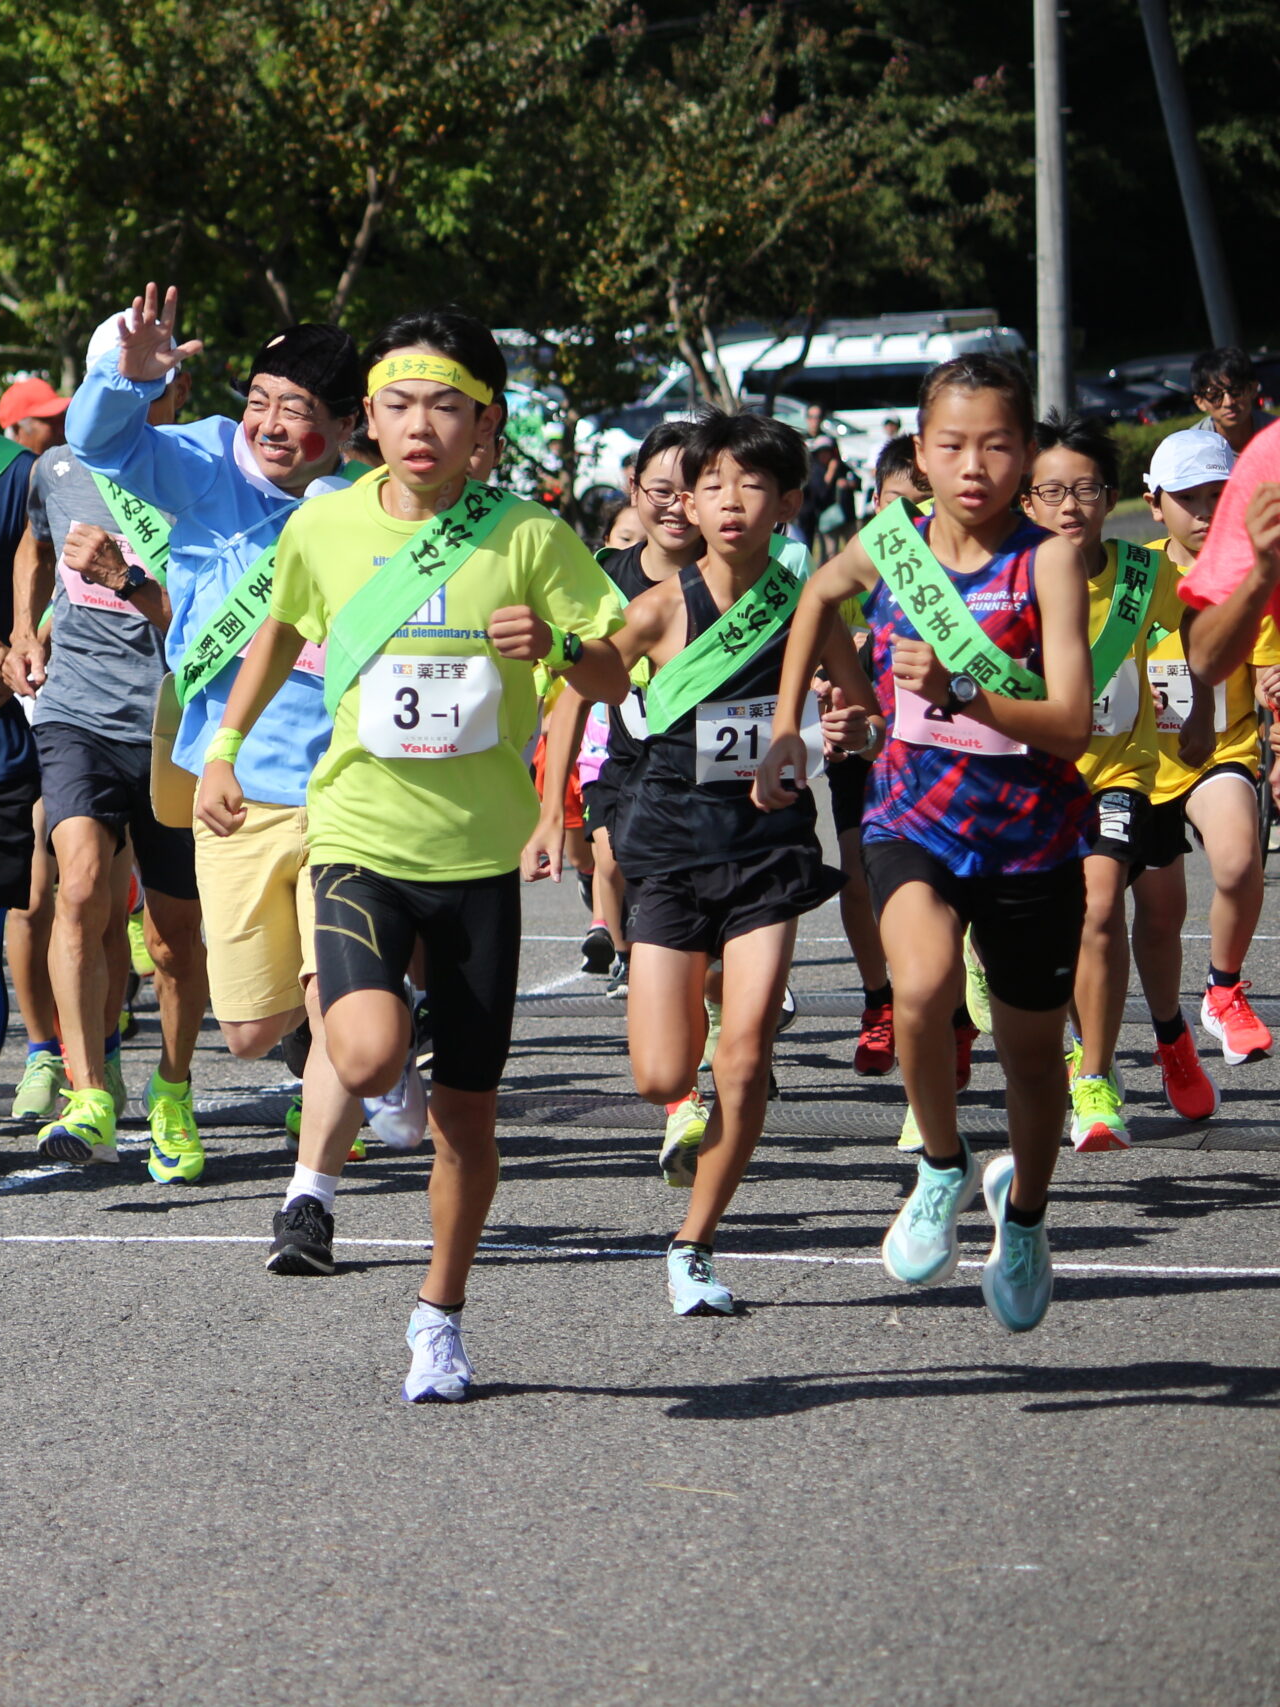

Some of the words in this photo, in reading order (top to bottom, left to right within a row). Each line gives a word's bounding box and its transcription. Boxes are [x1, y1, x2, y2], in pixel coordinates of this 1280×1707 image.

[386, 360, 463, 383] 喜多方二小
[82, 594, 126, 610] Yakult
[183, 557, 276, 684] ま一周駅伝
[411, 627, 471, 640] elementary
[417, 663, 468, 680] 薬王堂
[400, 743, 459, 754] Yakult
[931, 732, 983, 749] Yakult
